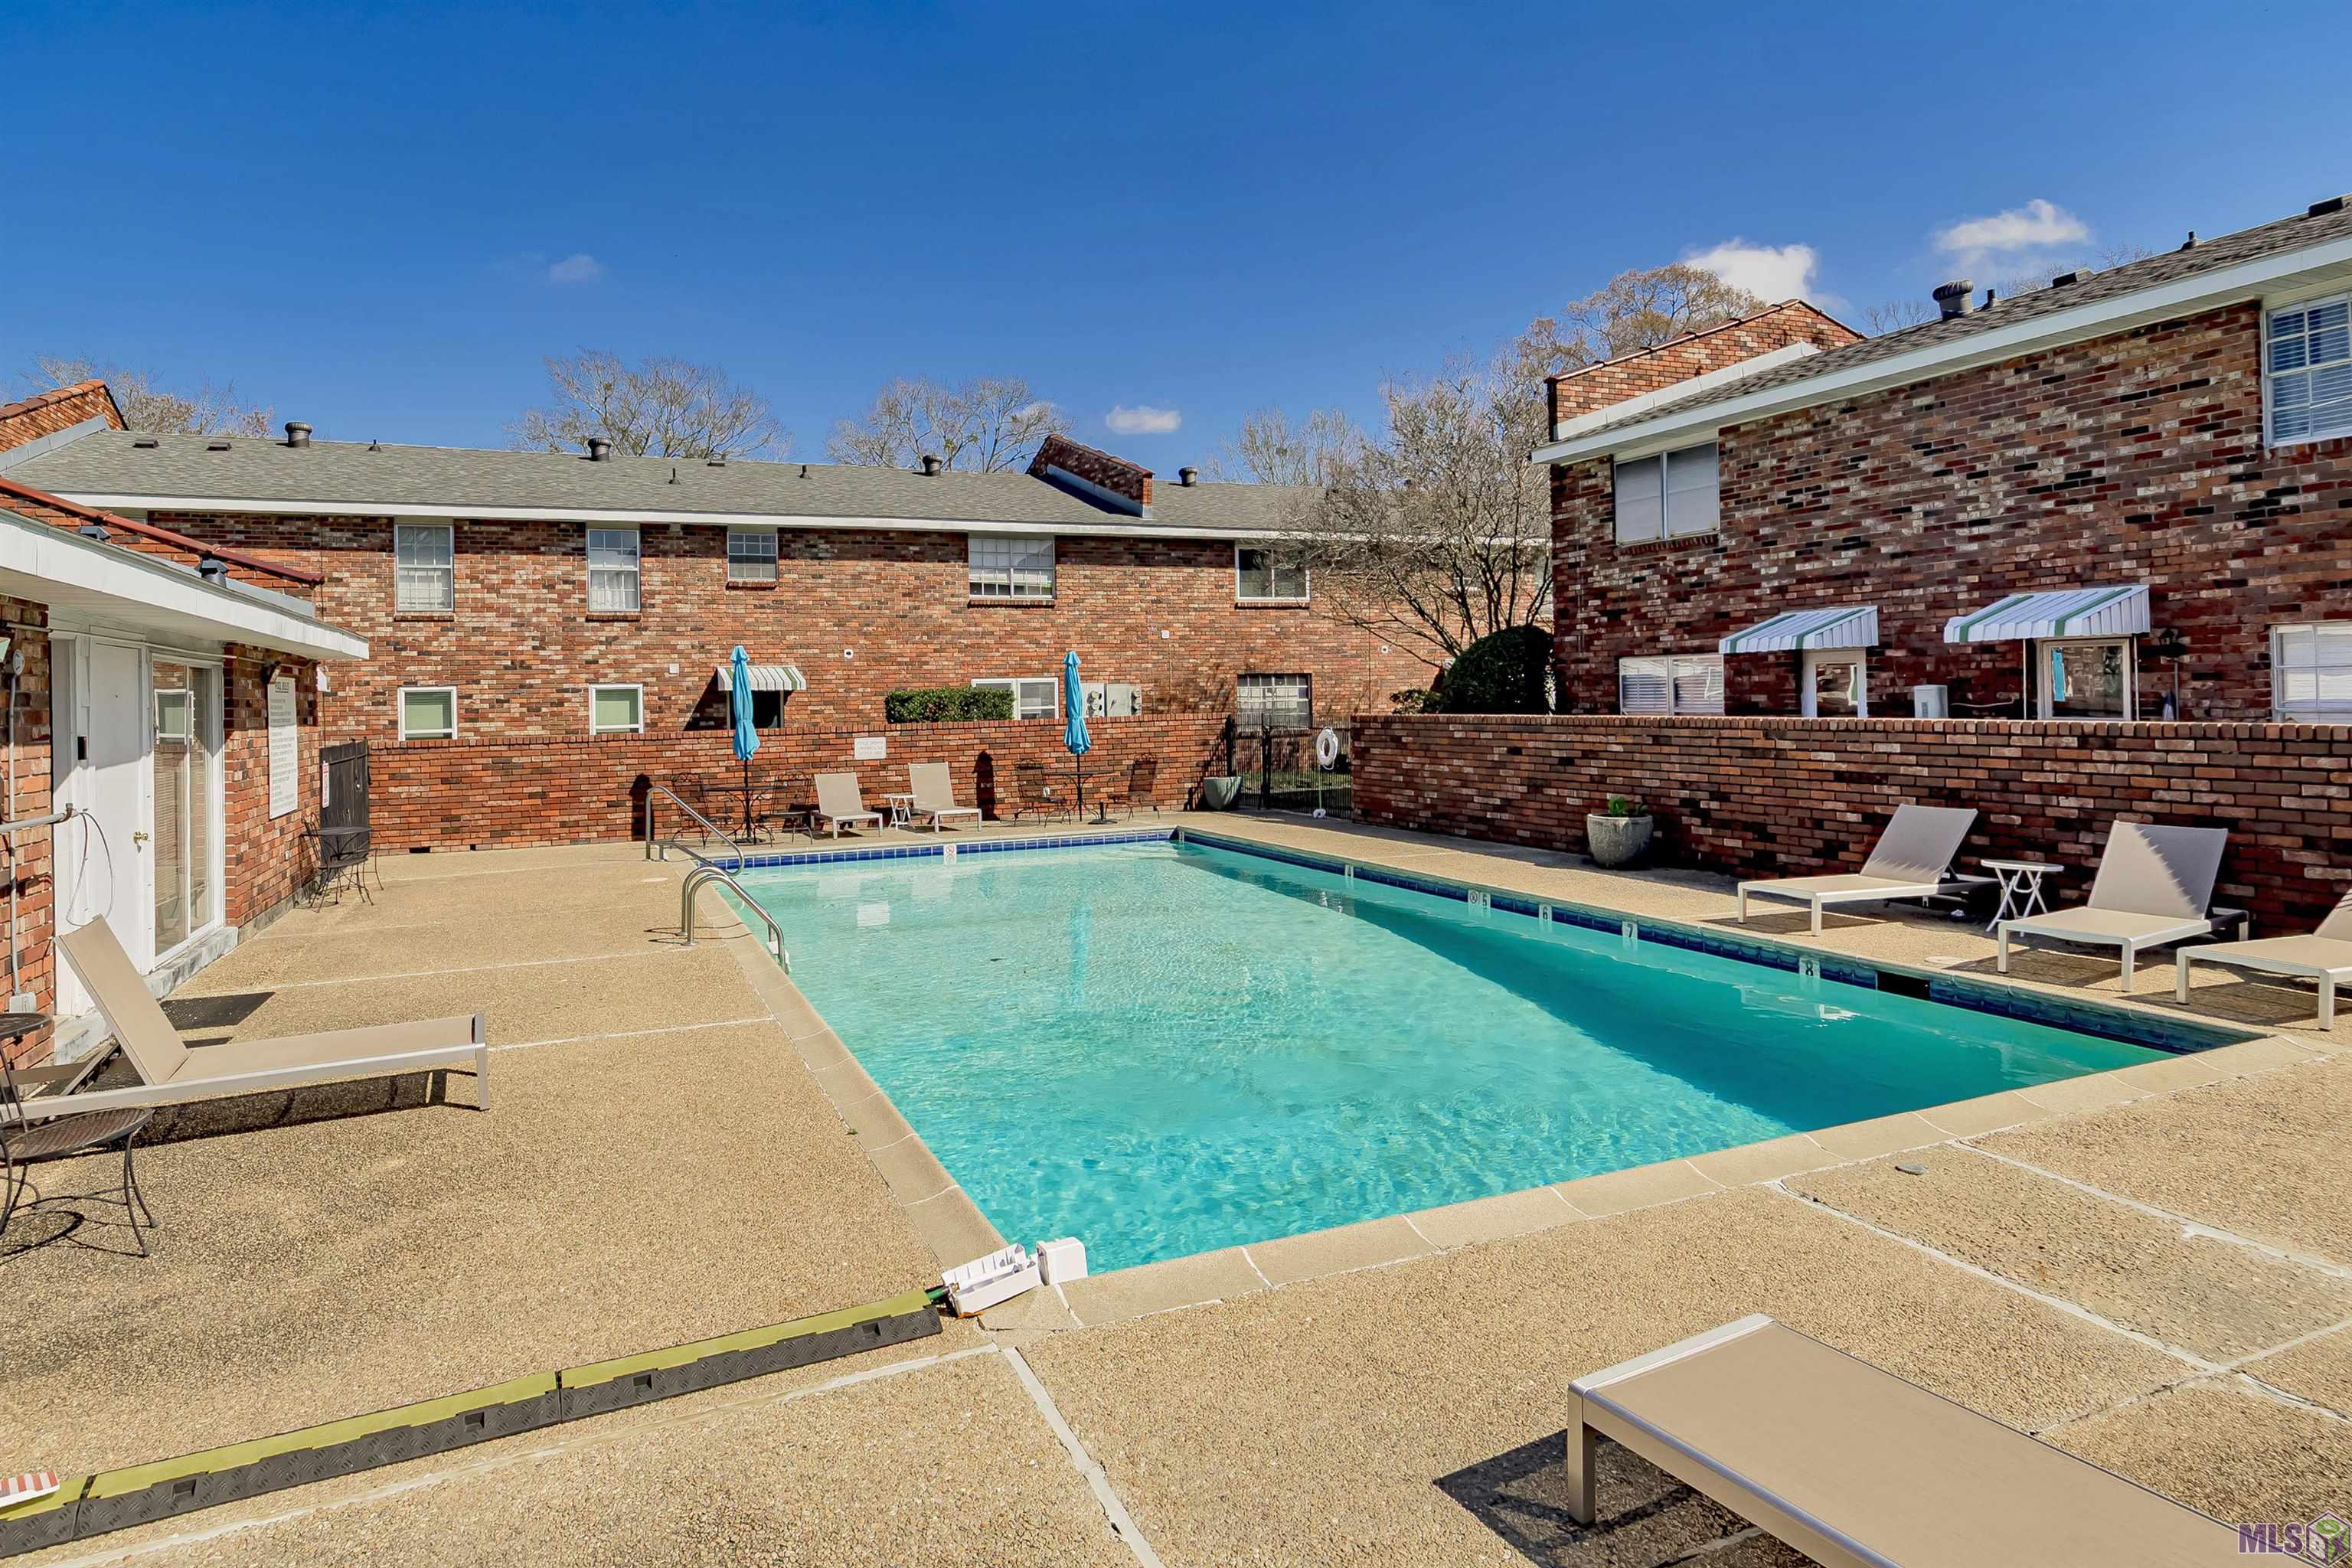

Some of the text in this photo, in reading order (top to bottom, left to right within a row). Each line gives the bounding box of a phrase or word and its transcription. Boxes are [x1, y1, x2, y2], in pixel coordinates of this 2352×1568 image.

[1542, 906, 1548, 920] 6
[1628, 923, 1633, 938] 7
[1805, 961, 1813, 976] 8
